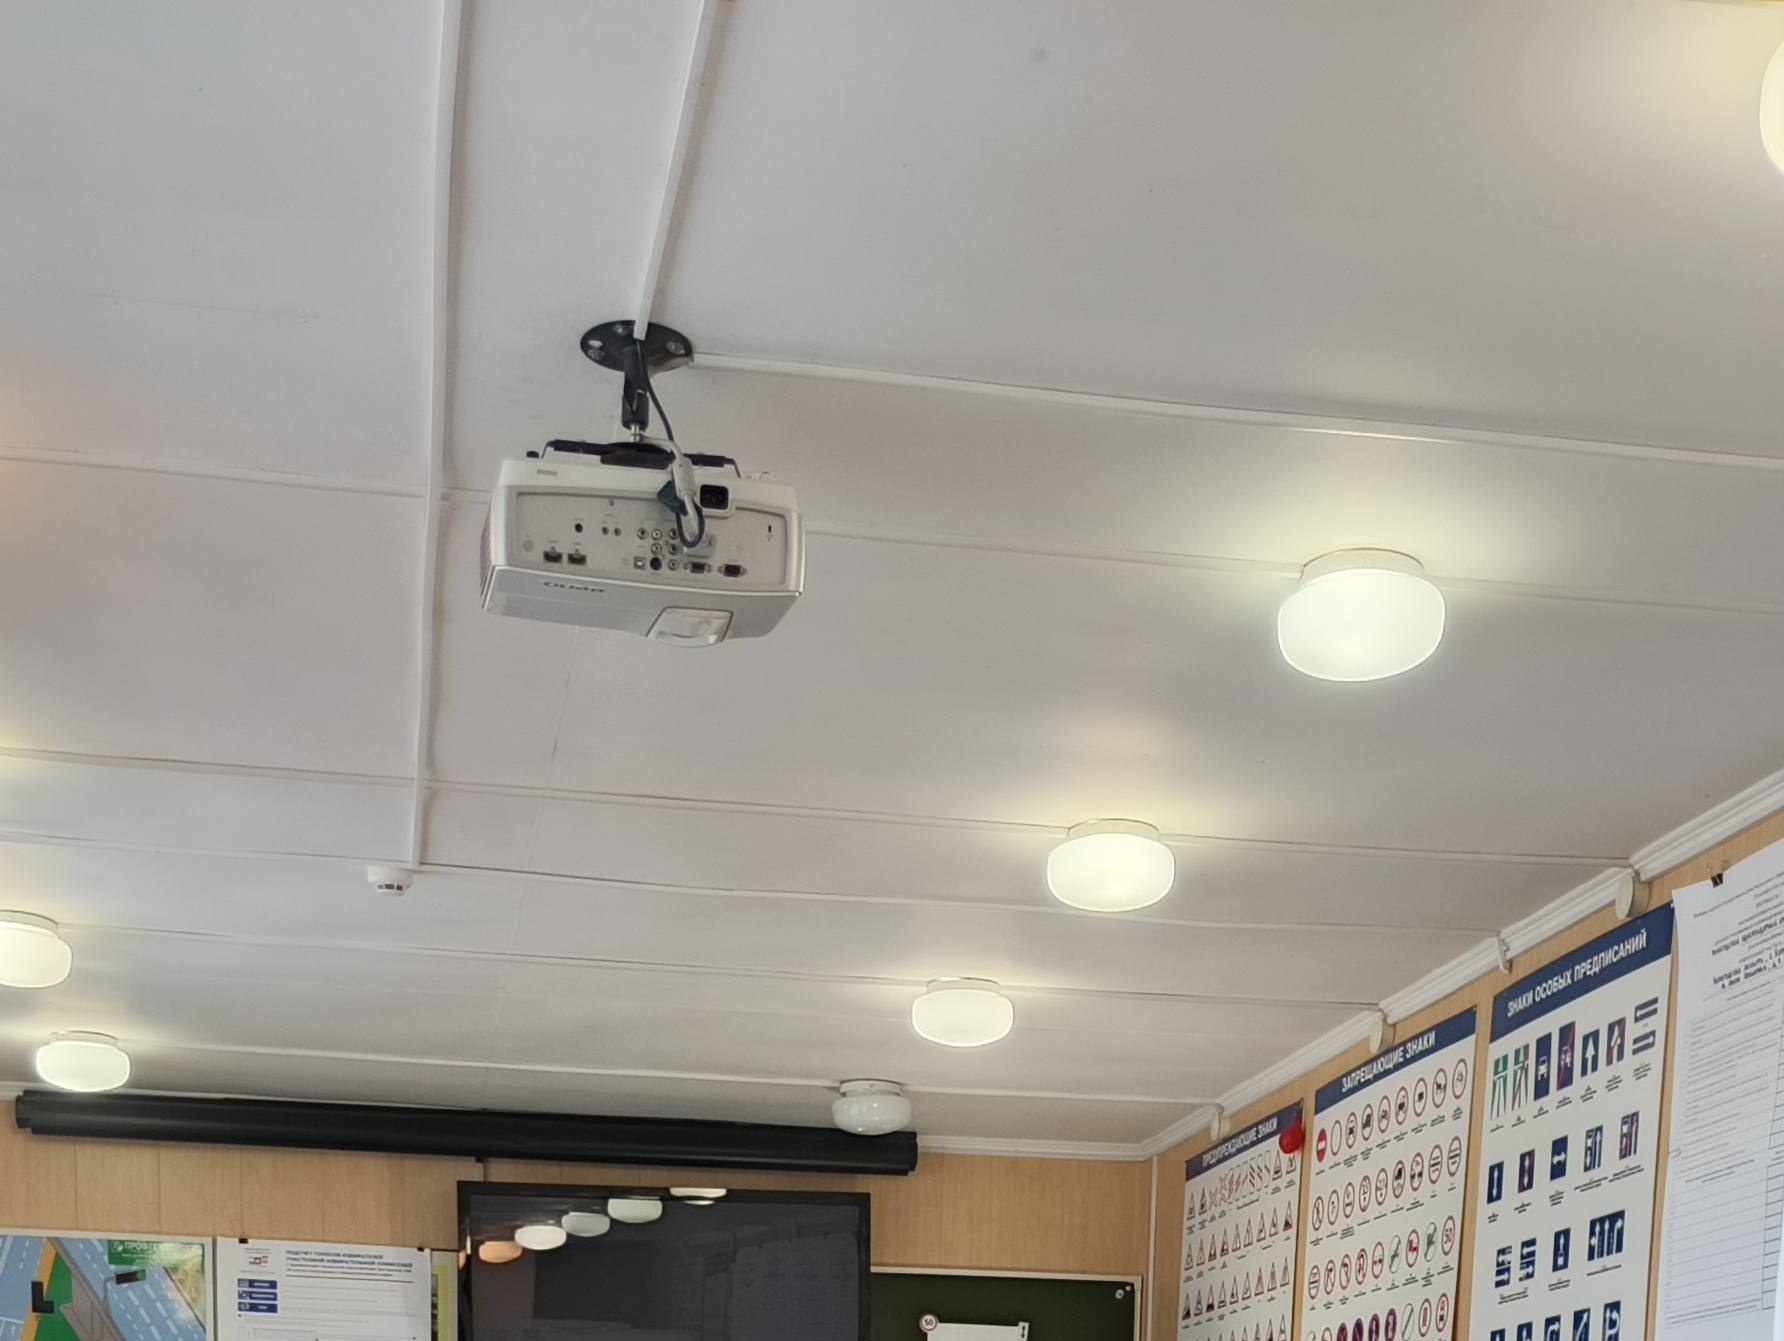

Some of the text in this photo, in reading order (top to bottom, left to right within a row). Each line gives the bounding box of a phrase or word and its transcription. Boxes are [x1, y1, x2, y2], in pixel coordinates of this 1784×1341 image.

[1507, 928, 1648, 1017] ЗНАКИ ОСОБЫХ ПРЕДПИСАНИЙ
[1341, 1030, 1436, 1093] ЗАПРЕЩАЮЩИЕ ЗНАКИ
